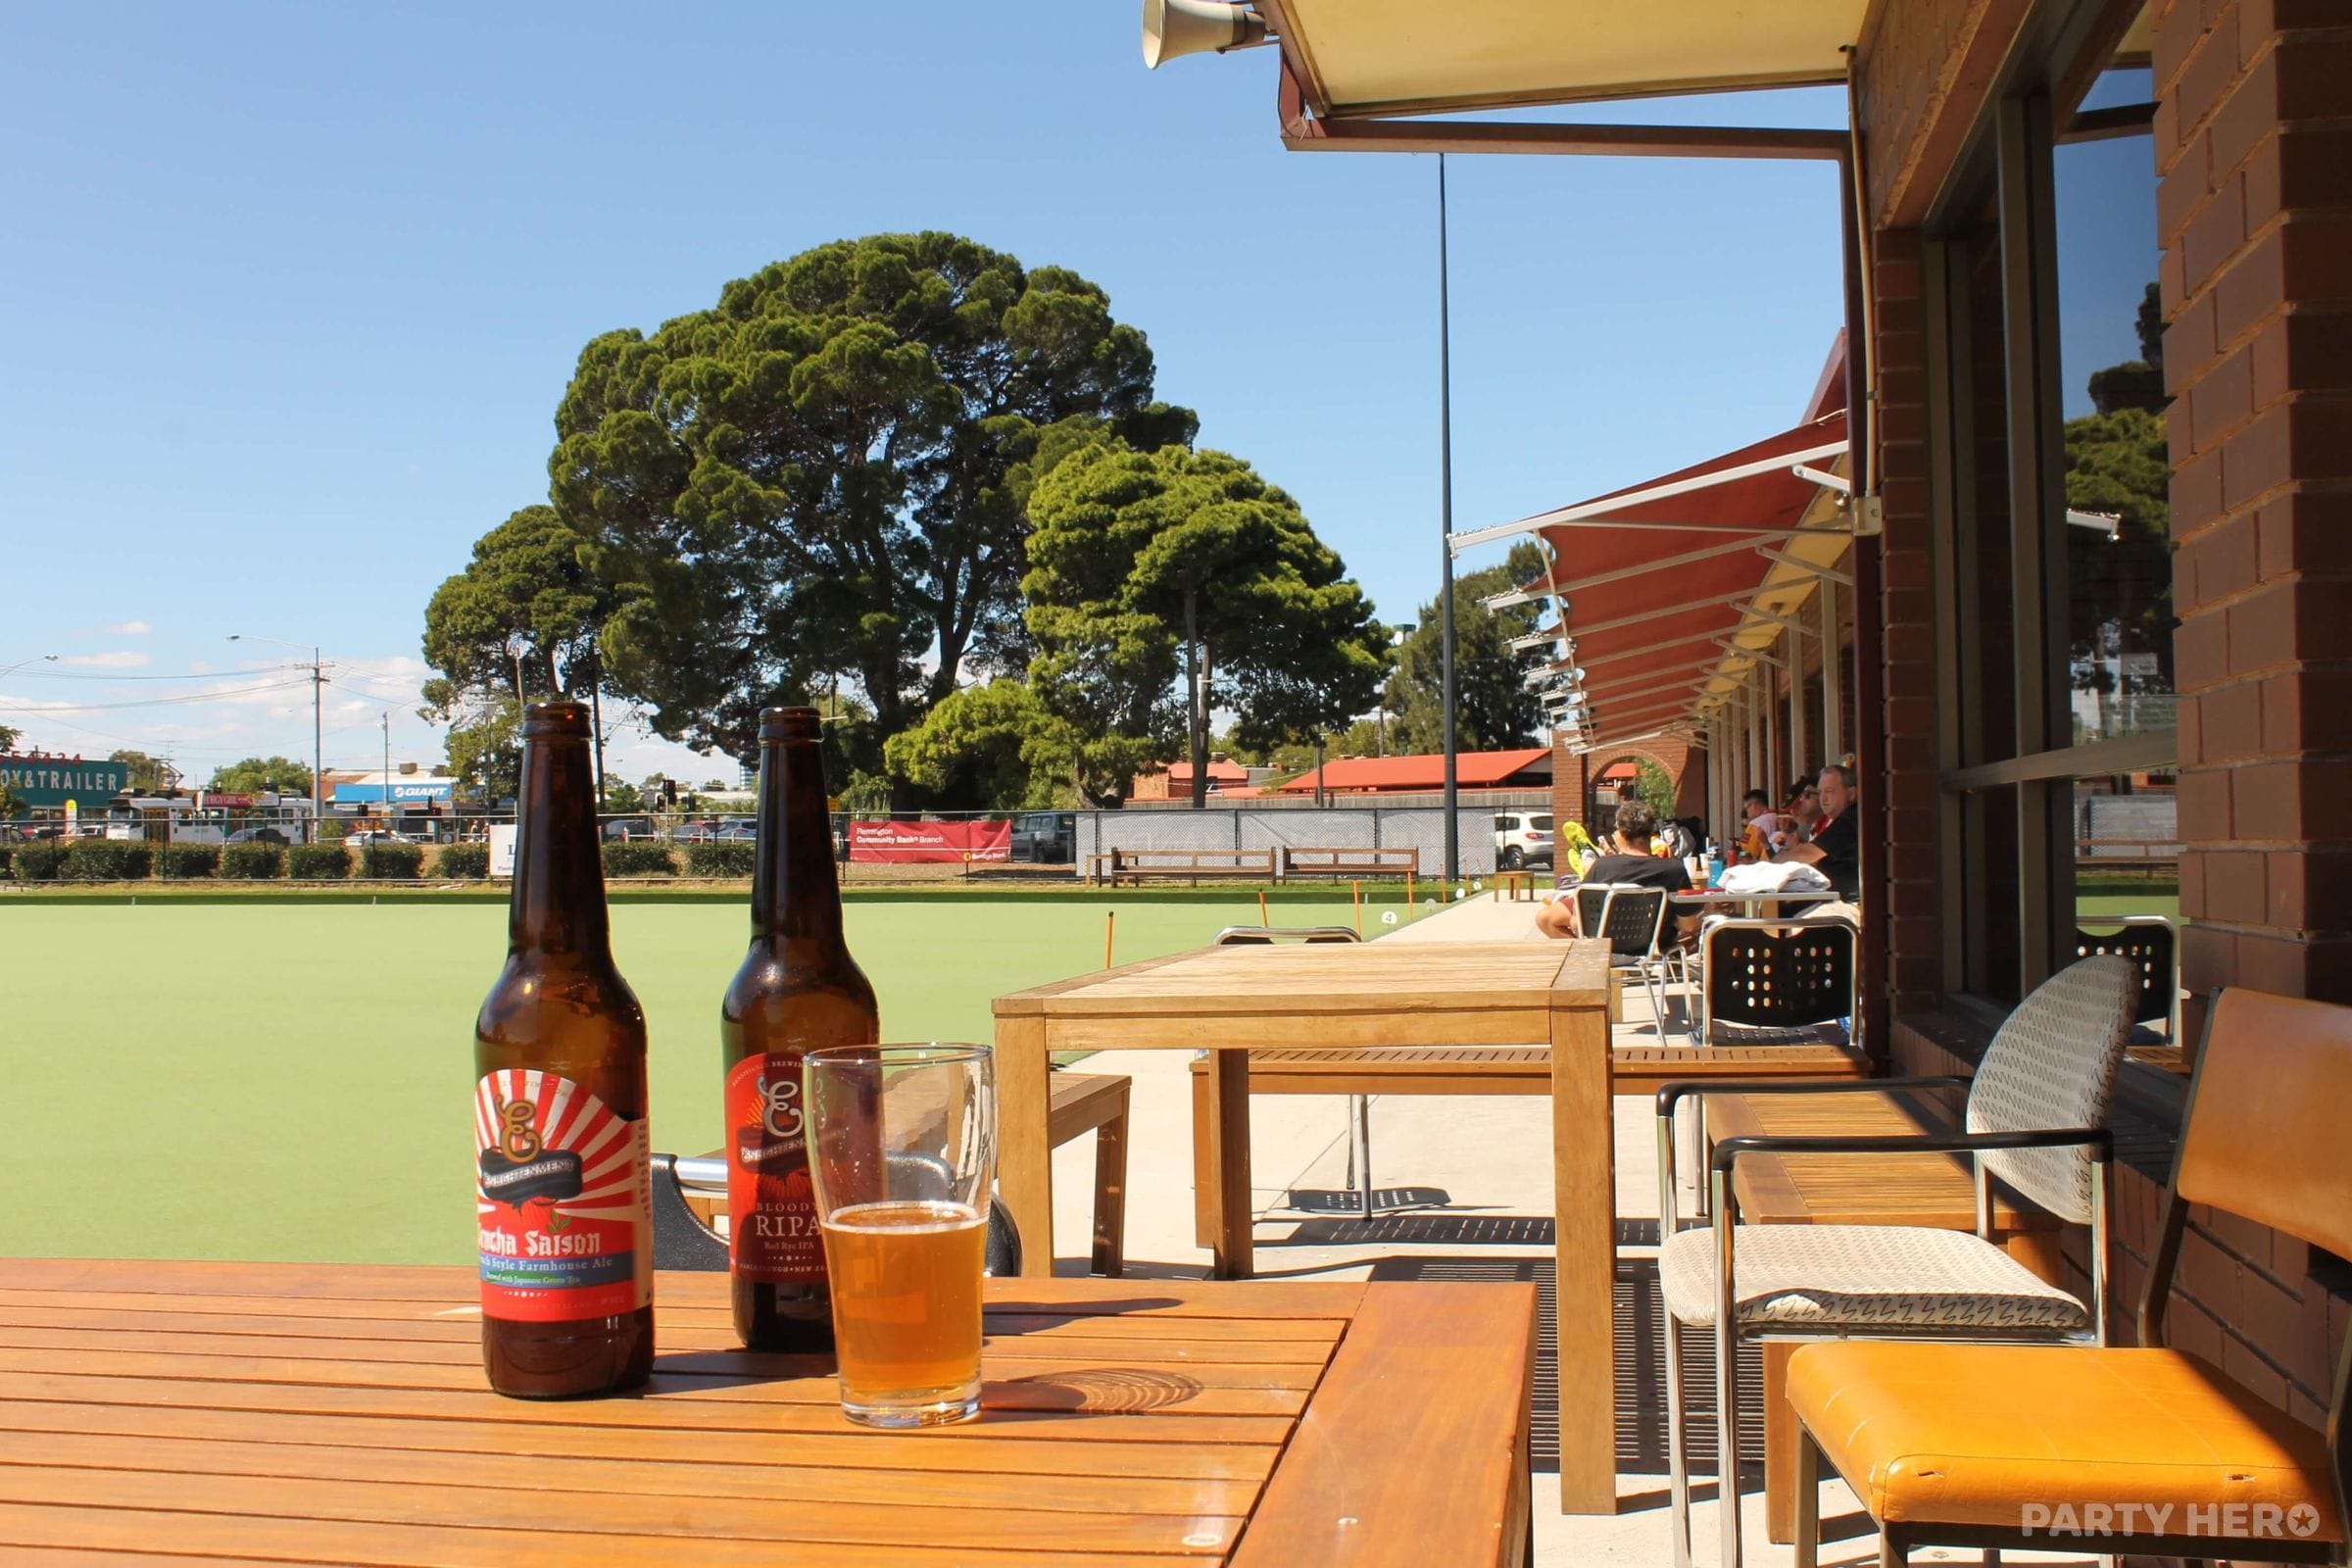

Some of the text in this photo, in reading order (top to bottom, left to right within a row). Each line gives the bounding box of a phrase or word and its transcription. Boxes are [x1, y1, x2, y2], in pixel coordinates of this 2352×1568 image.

[405, 787, 447, 796] GIANT
[1385, 913, 1392, 922] 4
[756, 1214, 822, 1237] RIPA
[479, 1224, 601, 1257] ncha Saison
[492, 1256, 515, 1271] Style
[519, 1260, 588, 1272] Farmhouse
[592, 1257, 612, 1268] Ale
[514, 1275, 541, 1285] Japanese
